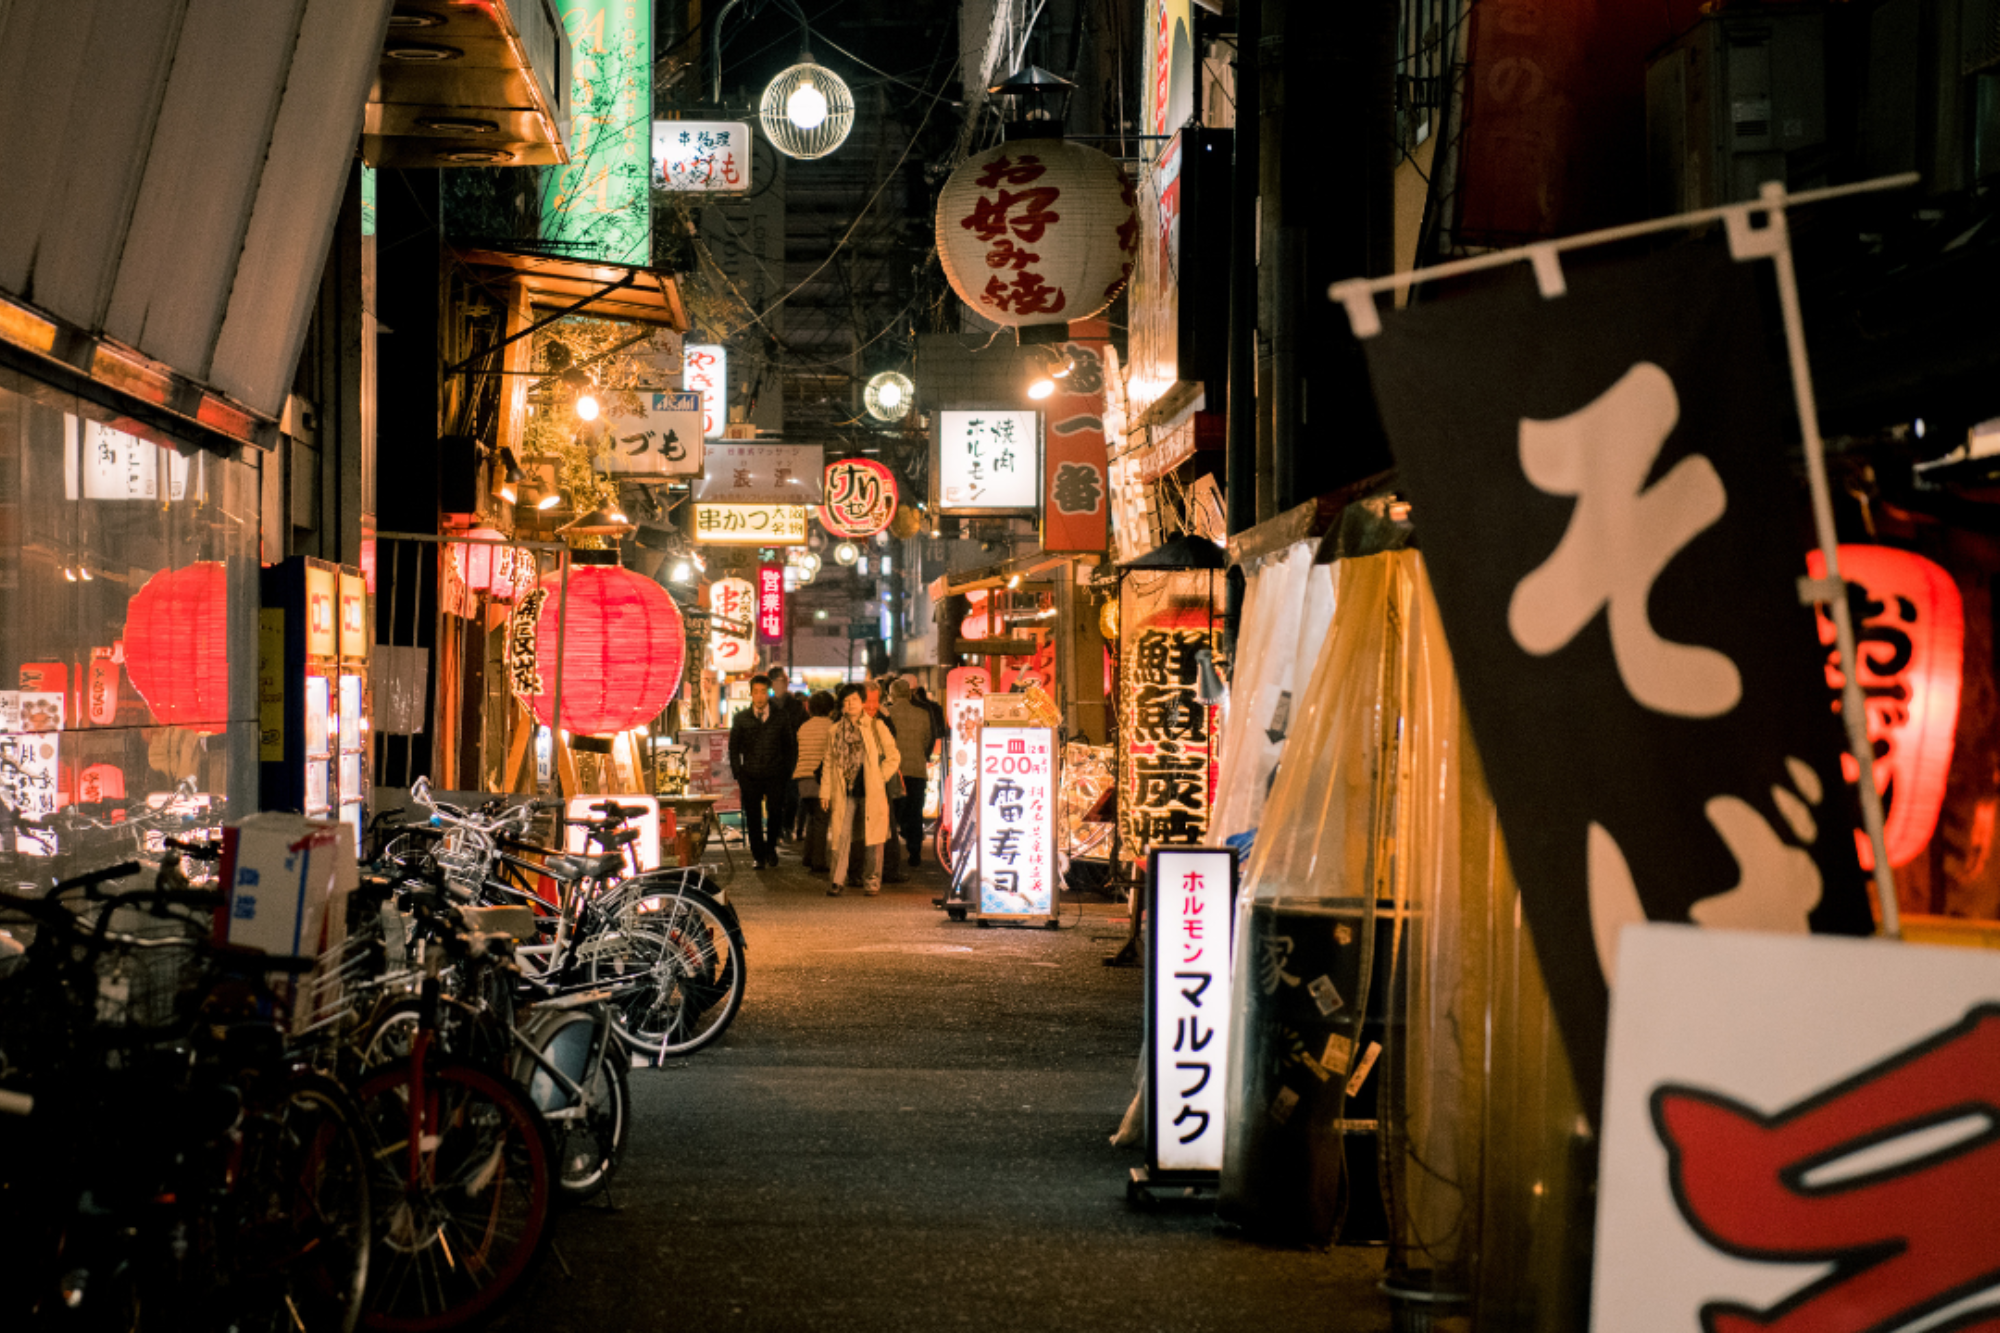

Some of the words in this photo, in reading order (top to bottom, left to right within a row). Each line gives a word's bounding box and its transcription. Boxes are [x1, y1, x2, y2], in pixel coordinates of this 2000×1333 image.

[961, 155, 1066, 315] お好み焼
[966, 418, 986, 501] ホルモン
[698, 507, 770, 532] 串かつ
[762, 570, 782, 636] 営業中
[989, 777, 1026, 893] 雷寿司
[1182, 870, 1206, 964] ホルモン
[1172, 971, 1215, 1146] マルフク
